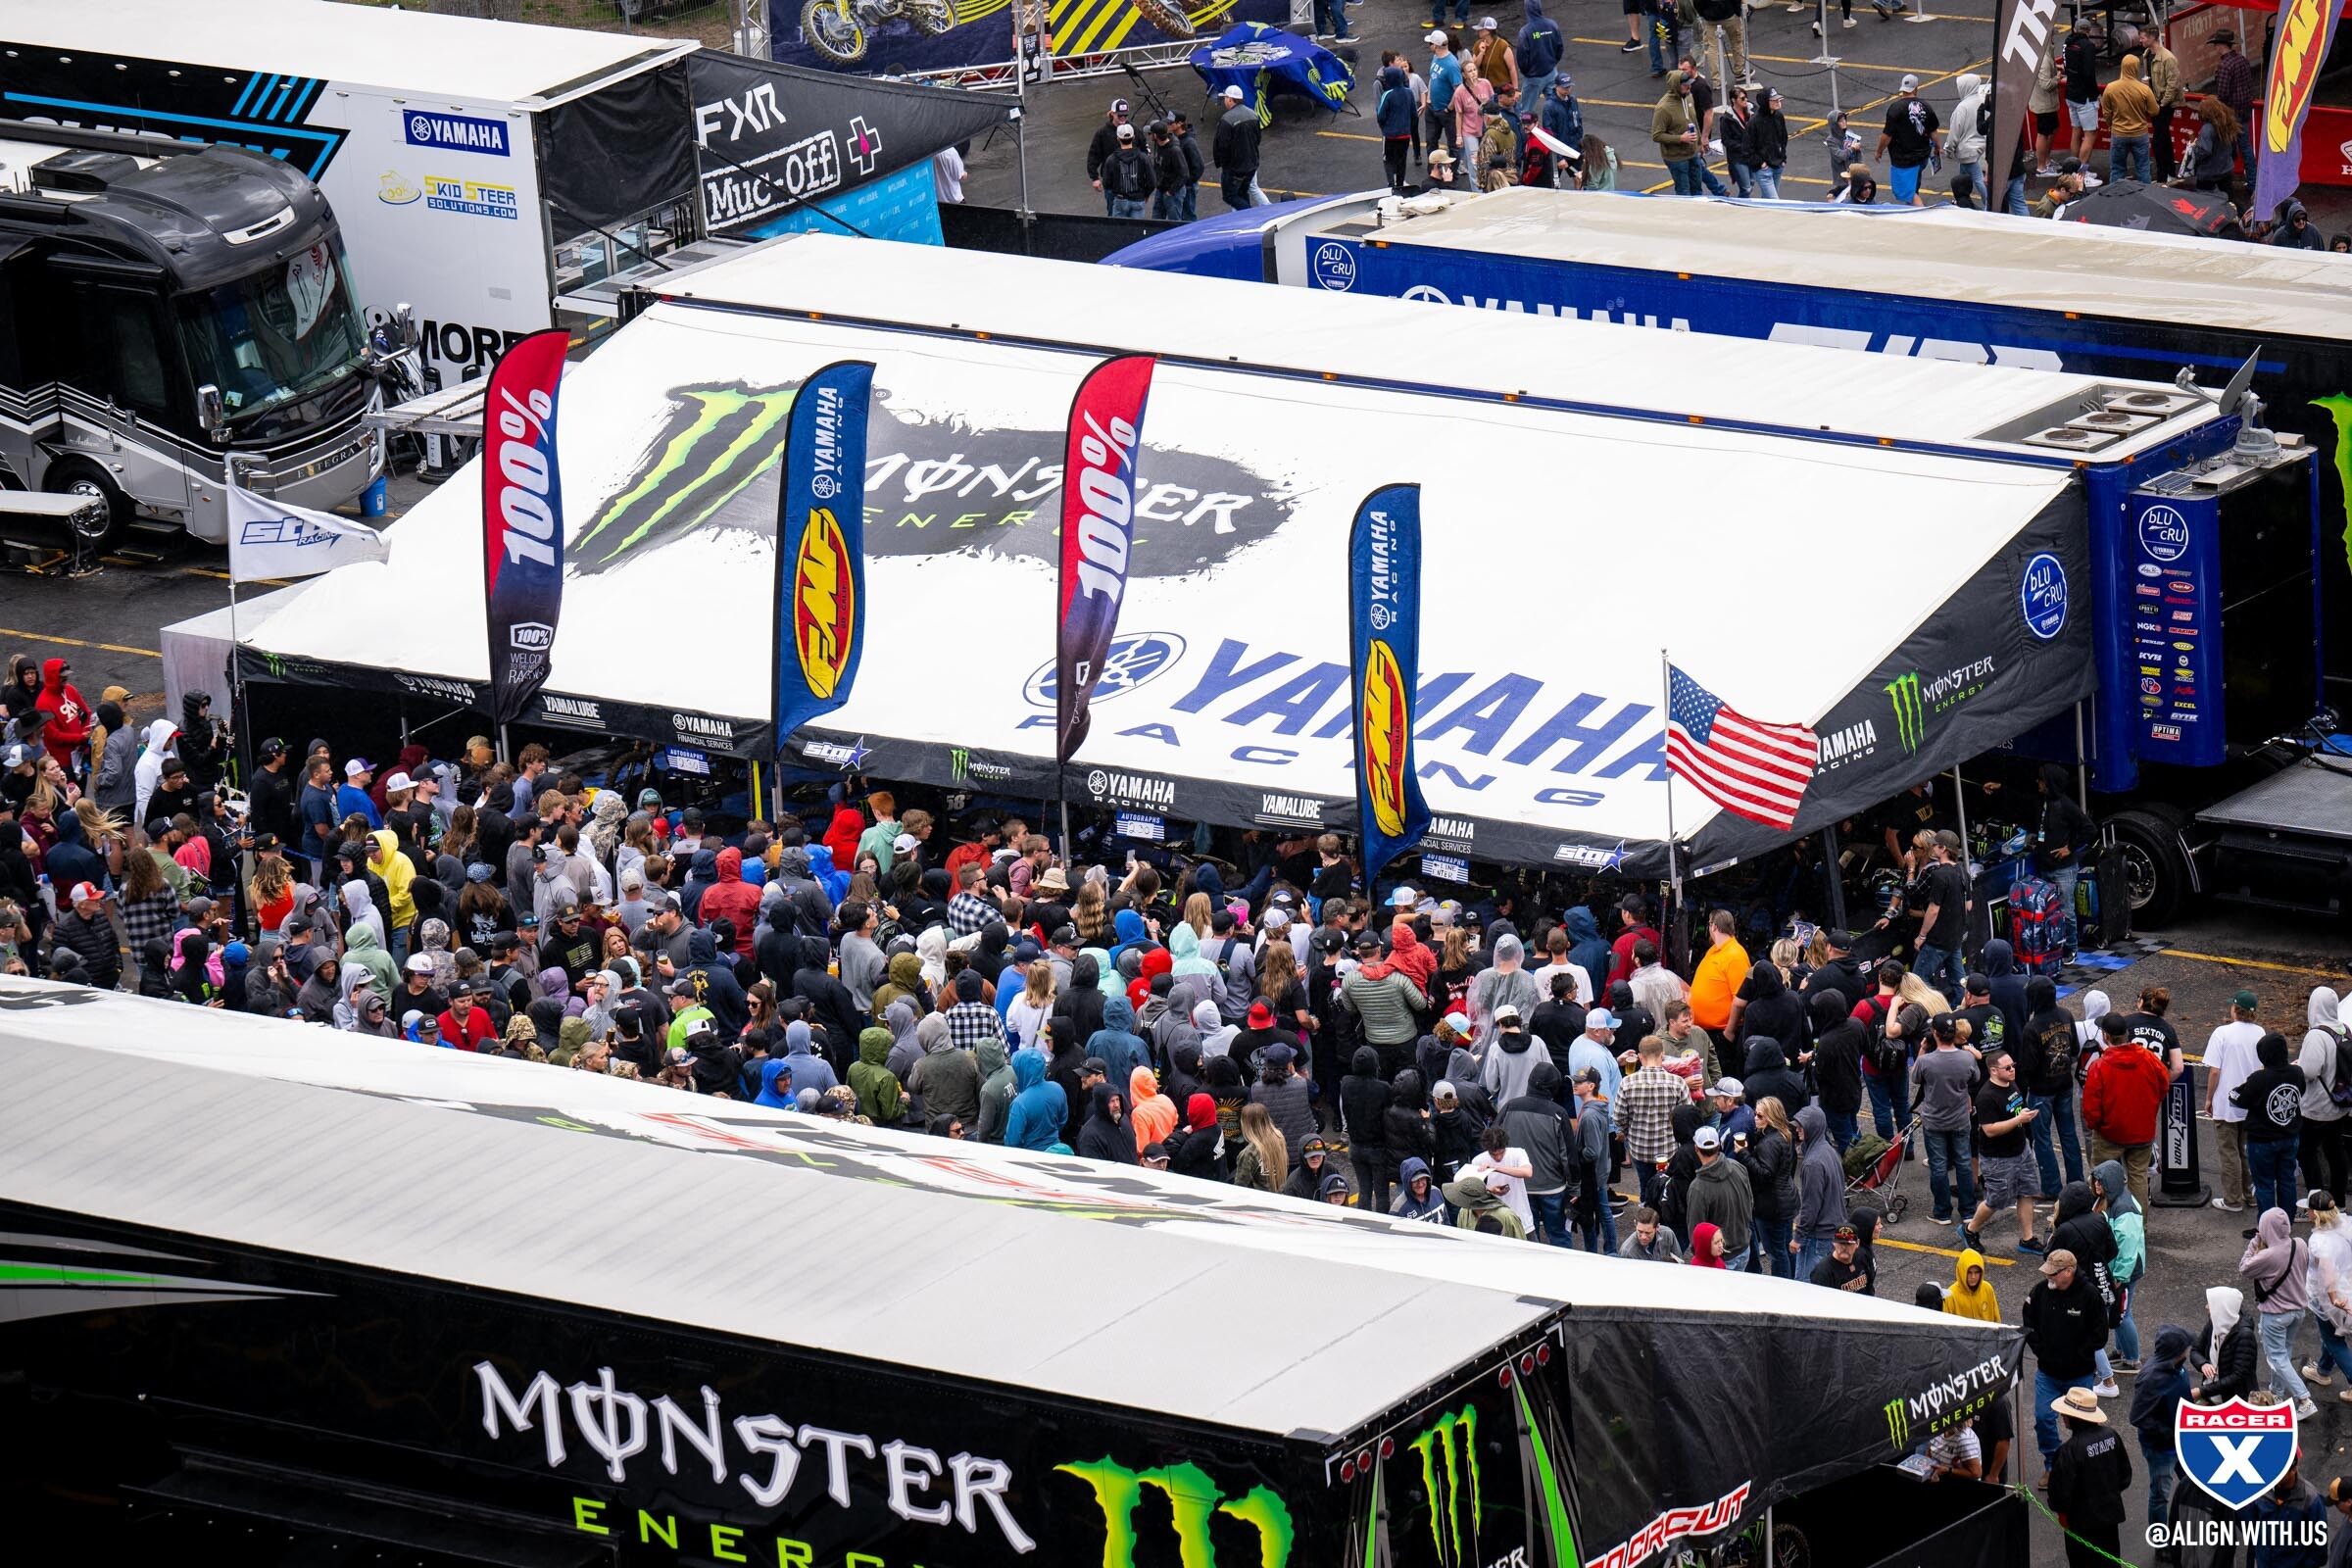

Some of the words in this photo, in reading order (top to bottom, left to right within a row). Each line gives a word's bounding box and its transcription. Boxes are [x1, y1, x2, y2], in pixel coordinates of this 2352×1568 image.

[695, 82, 787, 150] FXR
[430, 119, 503, 149] YAMAHA
[424, 175, 462, 199] SKID
[465, 181, 516, 206] STEER
[708, 139, 837, 221] Muc-Off
[428, 198, 516, 220] SOLUTIONS.COM
[1322, 248, 1342, 261] bLU
[1332, 263, 1352, 276] cRU
[815, 388, 837, 471] YAMAHA
[500, 386, 556, 566] 100%
[864, 453, 1253, 533] MONSER
[1078, 410, 1137, 604] 100%
[2148, 511, 2173, 525] bLU
[2160, 528, 2184, 542] cRU
[1370, 511, 1389, 600] YAMAHA
[2031, 565, 2050, 592] bLU
[802, 508, 839, 699] FMF
[2044, 582, 2062, 607] cRU
[517, 629, 549, 645] 100%
[2136, 622, 2156, 631] NGK
[413, 676, 476, 699] YAMAHA
[1923, 656, 1995, 703] MONSTER
[409, 686, 473, 705] RACING
[542, 695, 600, 718] YAMALUBE
[1936, 682, 1984, 713] ENERGY
[686, 715, 732, 737] YAMAHA
[1367, 638, 1405, 835] FMF
[2153, 725, 2180, 735] OPTIMA
[677, 733, 707, 747] FINANCIAL
[707, 739, 733, 751] SERVICES
[805, 742, 857, 761] star
[670, 749, 704, 760] AUTOGRAPHS
[968, 761, 1010, 776] MONSTER
[1109, 773, 1174, 804] YAMAHA
[1094, 795, 1168, 811] RACING
[1263, 794, 1320, 819] YAMALUBE
[1121, 812, 1161, 824] AUTOGRAPHS
[1428, 816, 1474, 839] AMAHA
[1427, 853, 1465, 866] AUTOGRAPHS
[1441, 842, 1472, 855] SERVICES
[1556, 846, 1615, 866] star
[2134, 1027, 2165, 1042] SEXTON
[1909, 1354, 2008, 1419] MONSTER
[1931, 1391, 1995, 1433] ENERGY
[474, 1360, 1035, 1553] MONSTER
[2085, 1437, 2116, 1457] STAFF
[573, 1496, 931, 1568] ENER
[1626, 1481, 1751, 1568] CIRCUIT
